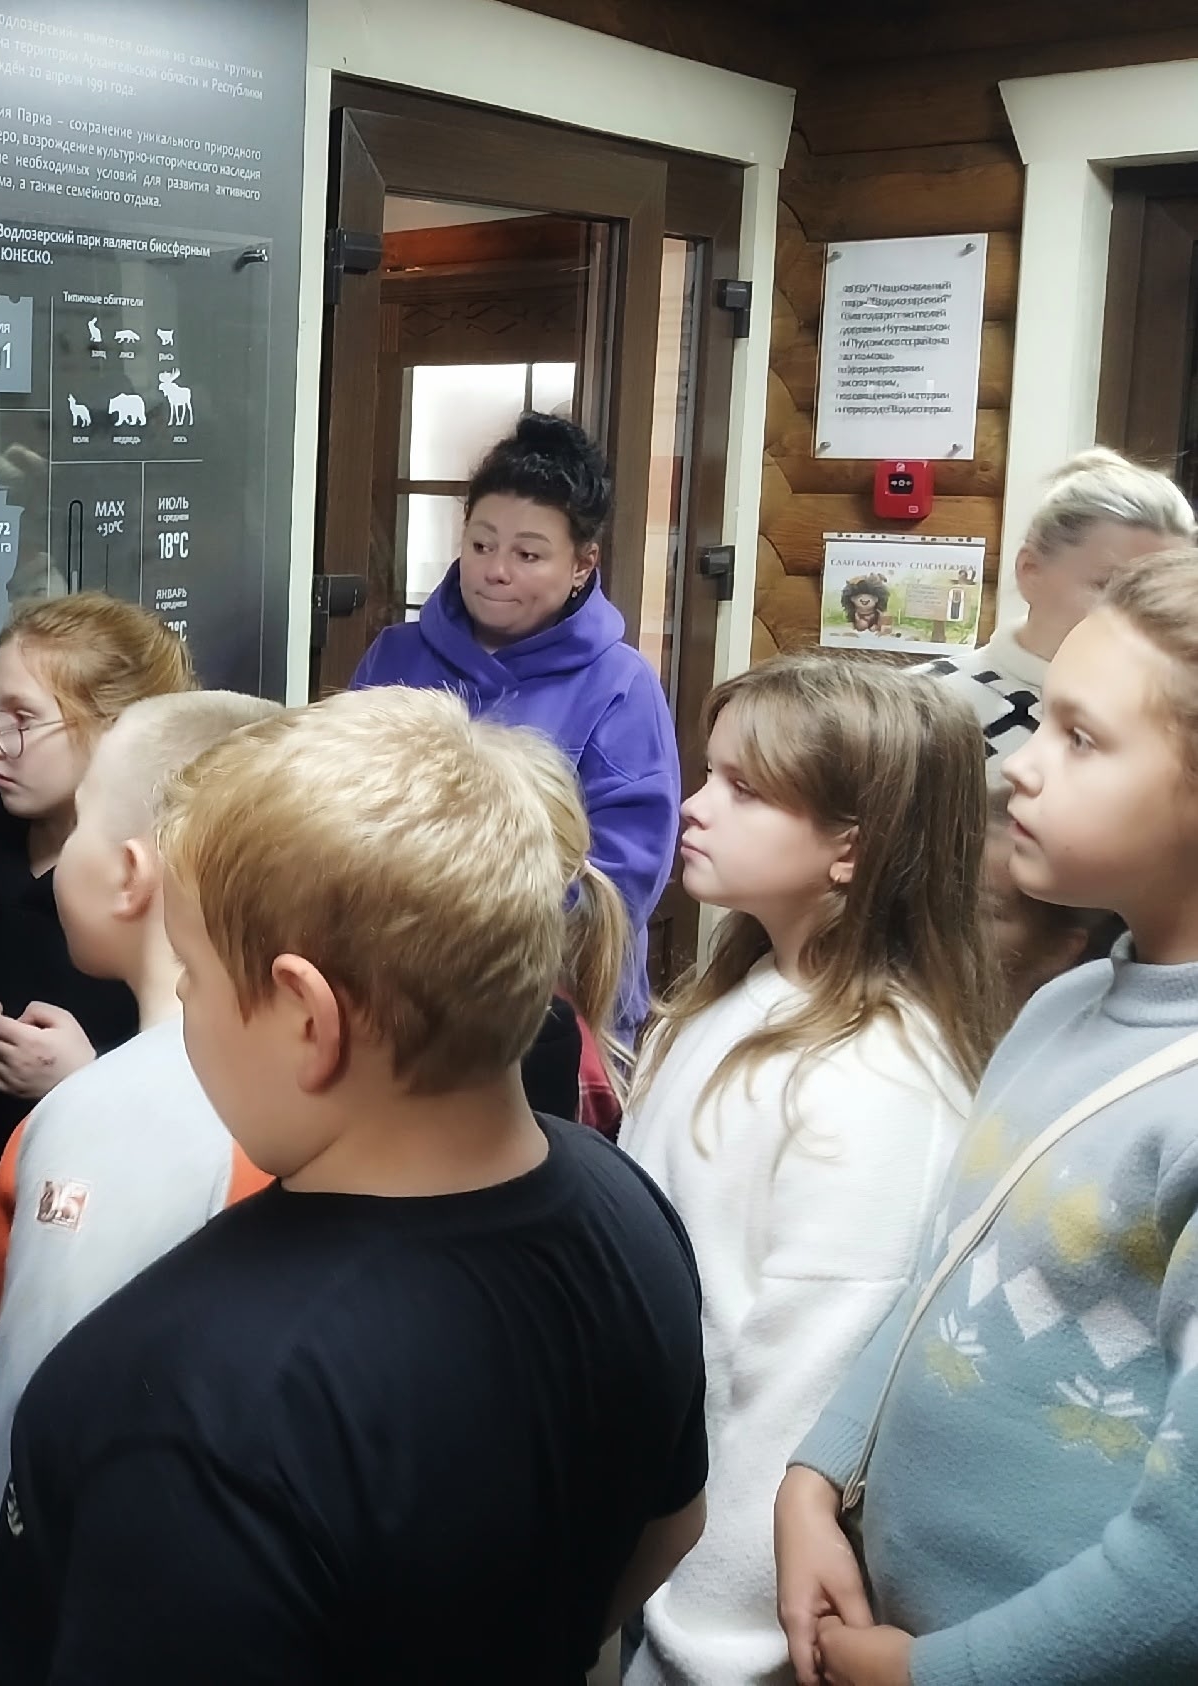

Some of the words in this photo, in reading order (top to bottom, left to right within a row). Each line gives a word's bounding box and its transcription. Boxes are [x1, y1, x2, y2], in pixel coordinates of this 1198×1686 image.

[30, 66, 42, 78] 20
[45, 70, 82, 86] апреля
[87, 77, 108, 93] 1991
[110, 81, 137, 97] года.
[161, 68, 199, 87] области
[212, 78, 263, 100] Республики
[224, 63, 263, 79] крупных
[17, 107, 52, 126] Парка
[69, 119, 133, 139] сохранение
[137, 130, 201, 150] уникального
[204, 141, 261, 161] природного
[22, 133, 95, 155] возрождение
[97, 145, 218, 174] культурно-исторического
[219, 165, 261, 181] наследия
[15, 155, 90, 175] необходимых
[96, 167, 137, 183] условий
[143, 174, 162, 188] для
[167, 177, 210, 193] развития
[215, 184, 260, 201] активного
[19, 178, 26, 190] а
[30, 180, 62, 195] также
[66, 184, 121, 202] семейного
[123, 192, 162, 208] отдыха.
[1, 246, 54, 265] ЮНЕСКО.
[76, 233, 101, 250] парк
[103, 237, 148, 251] является
[149, 238, 211, 259] биосферным
[103, 294, 144, 307] обитатели
[158, 496, 189, 510] ИЮЛЬ
[155, 587, 188, 600] ЯНВАРЬ
